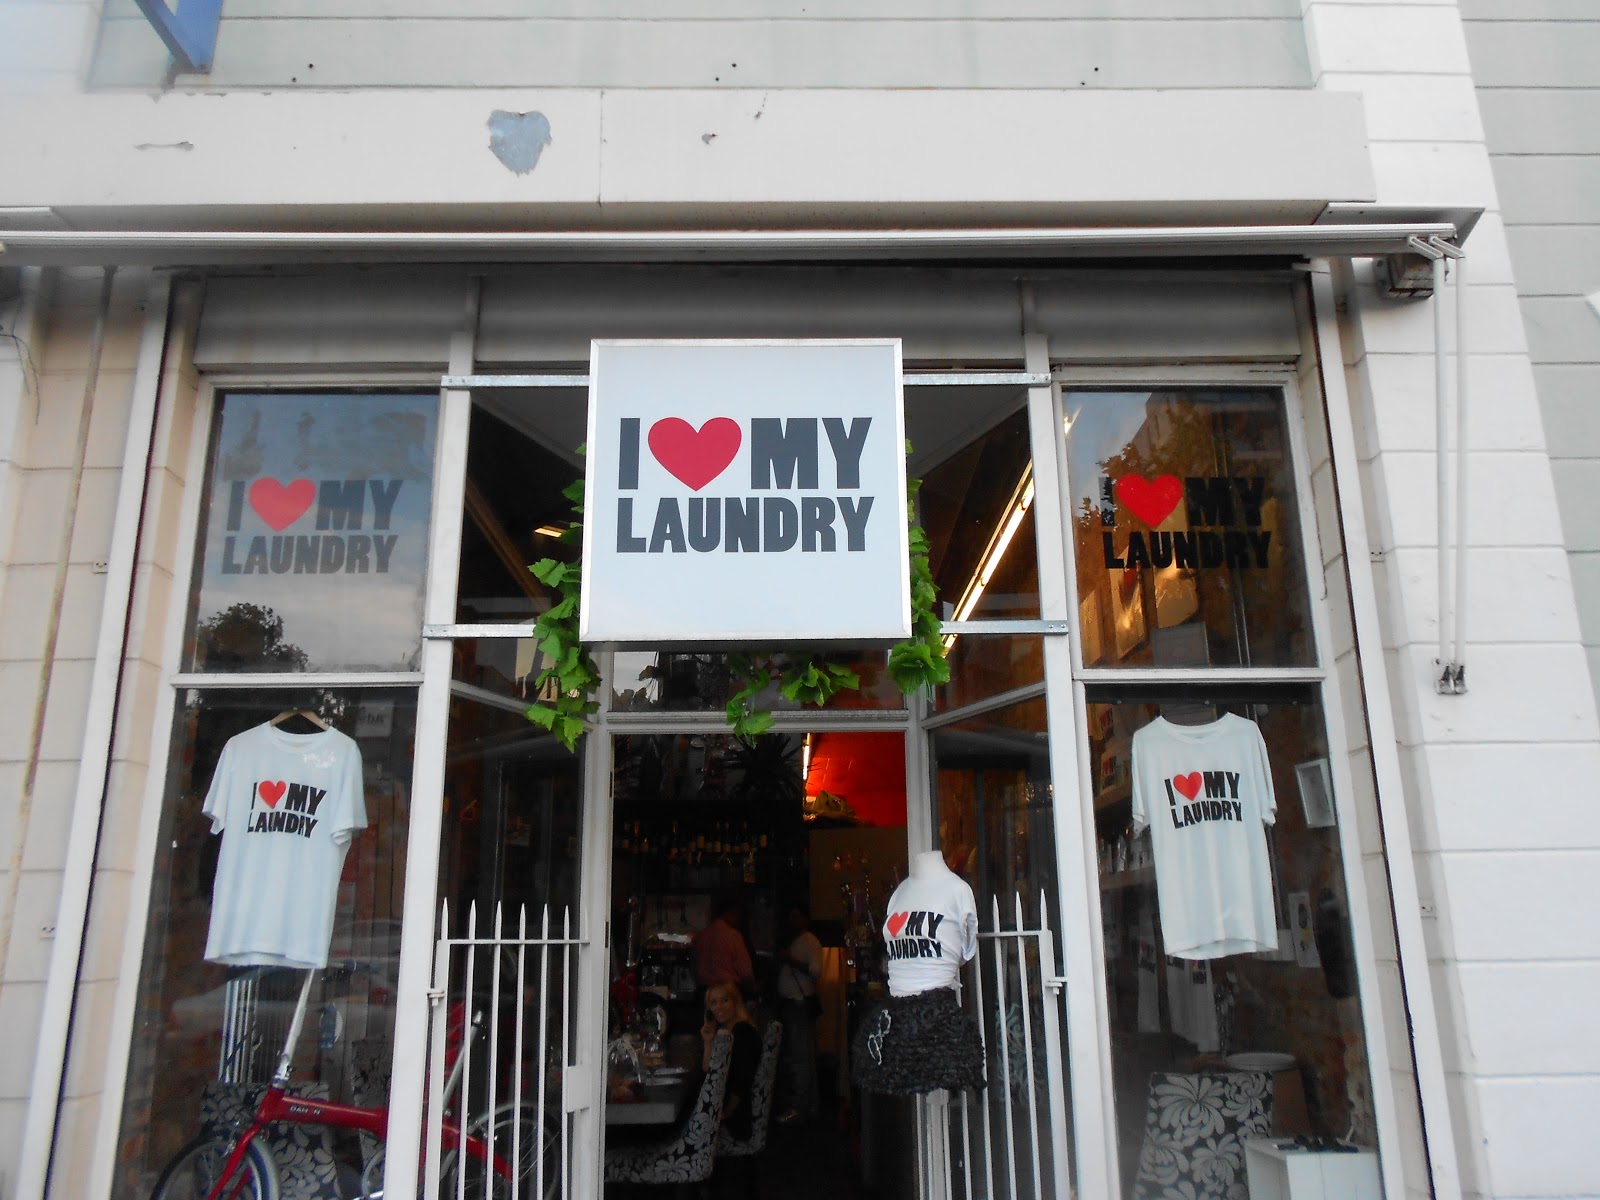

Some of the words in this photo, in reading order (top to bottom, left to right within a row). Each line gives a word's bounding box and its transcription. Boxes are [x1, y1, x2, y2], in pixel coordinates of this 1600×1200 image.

[618, 417, 641, 490] I
[750, 416, 873, 490] MY
[226, 480, 246, 531] I
[315, 479, 404, 531] MY
[1184, 476, 1265, 527] MY
[616, 496, 875, 553] LAUNDRY
[221, 534, 399, 575] LAUNDRY
[1102, 531, 1272, 569] LAUNDRY
[251, 782, 258, 810] I
[284, 783, 327, 816] MY
[1164, 778, 1177, 806] I
[1202, 771, 1240, 799] MY
[1171, 800, 1243, 829] LAUNDRY
[905, 911, 944, 939] MY
